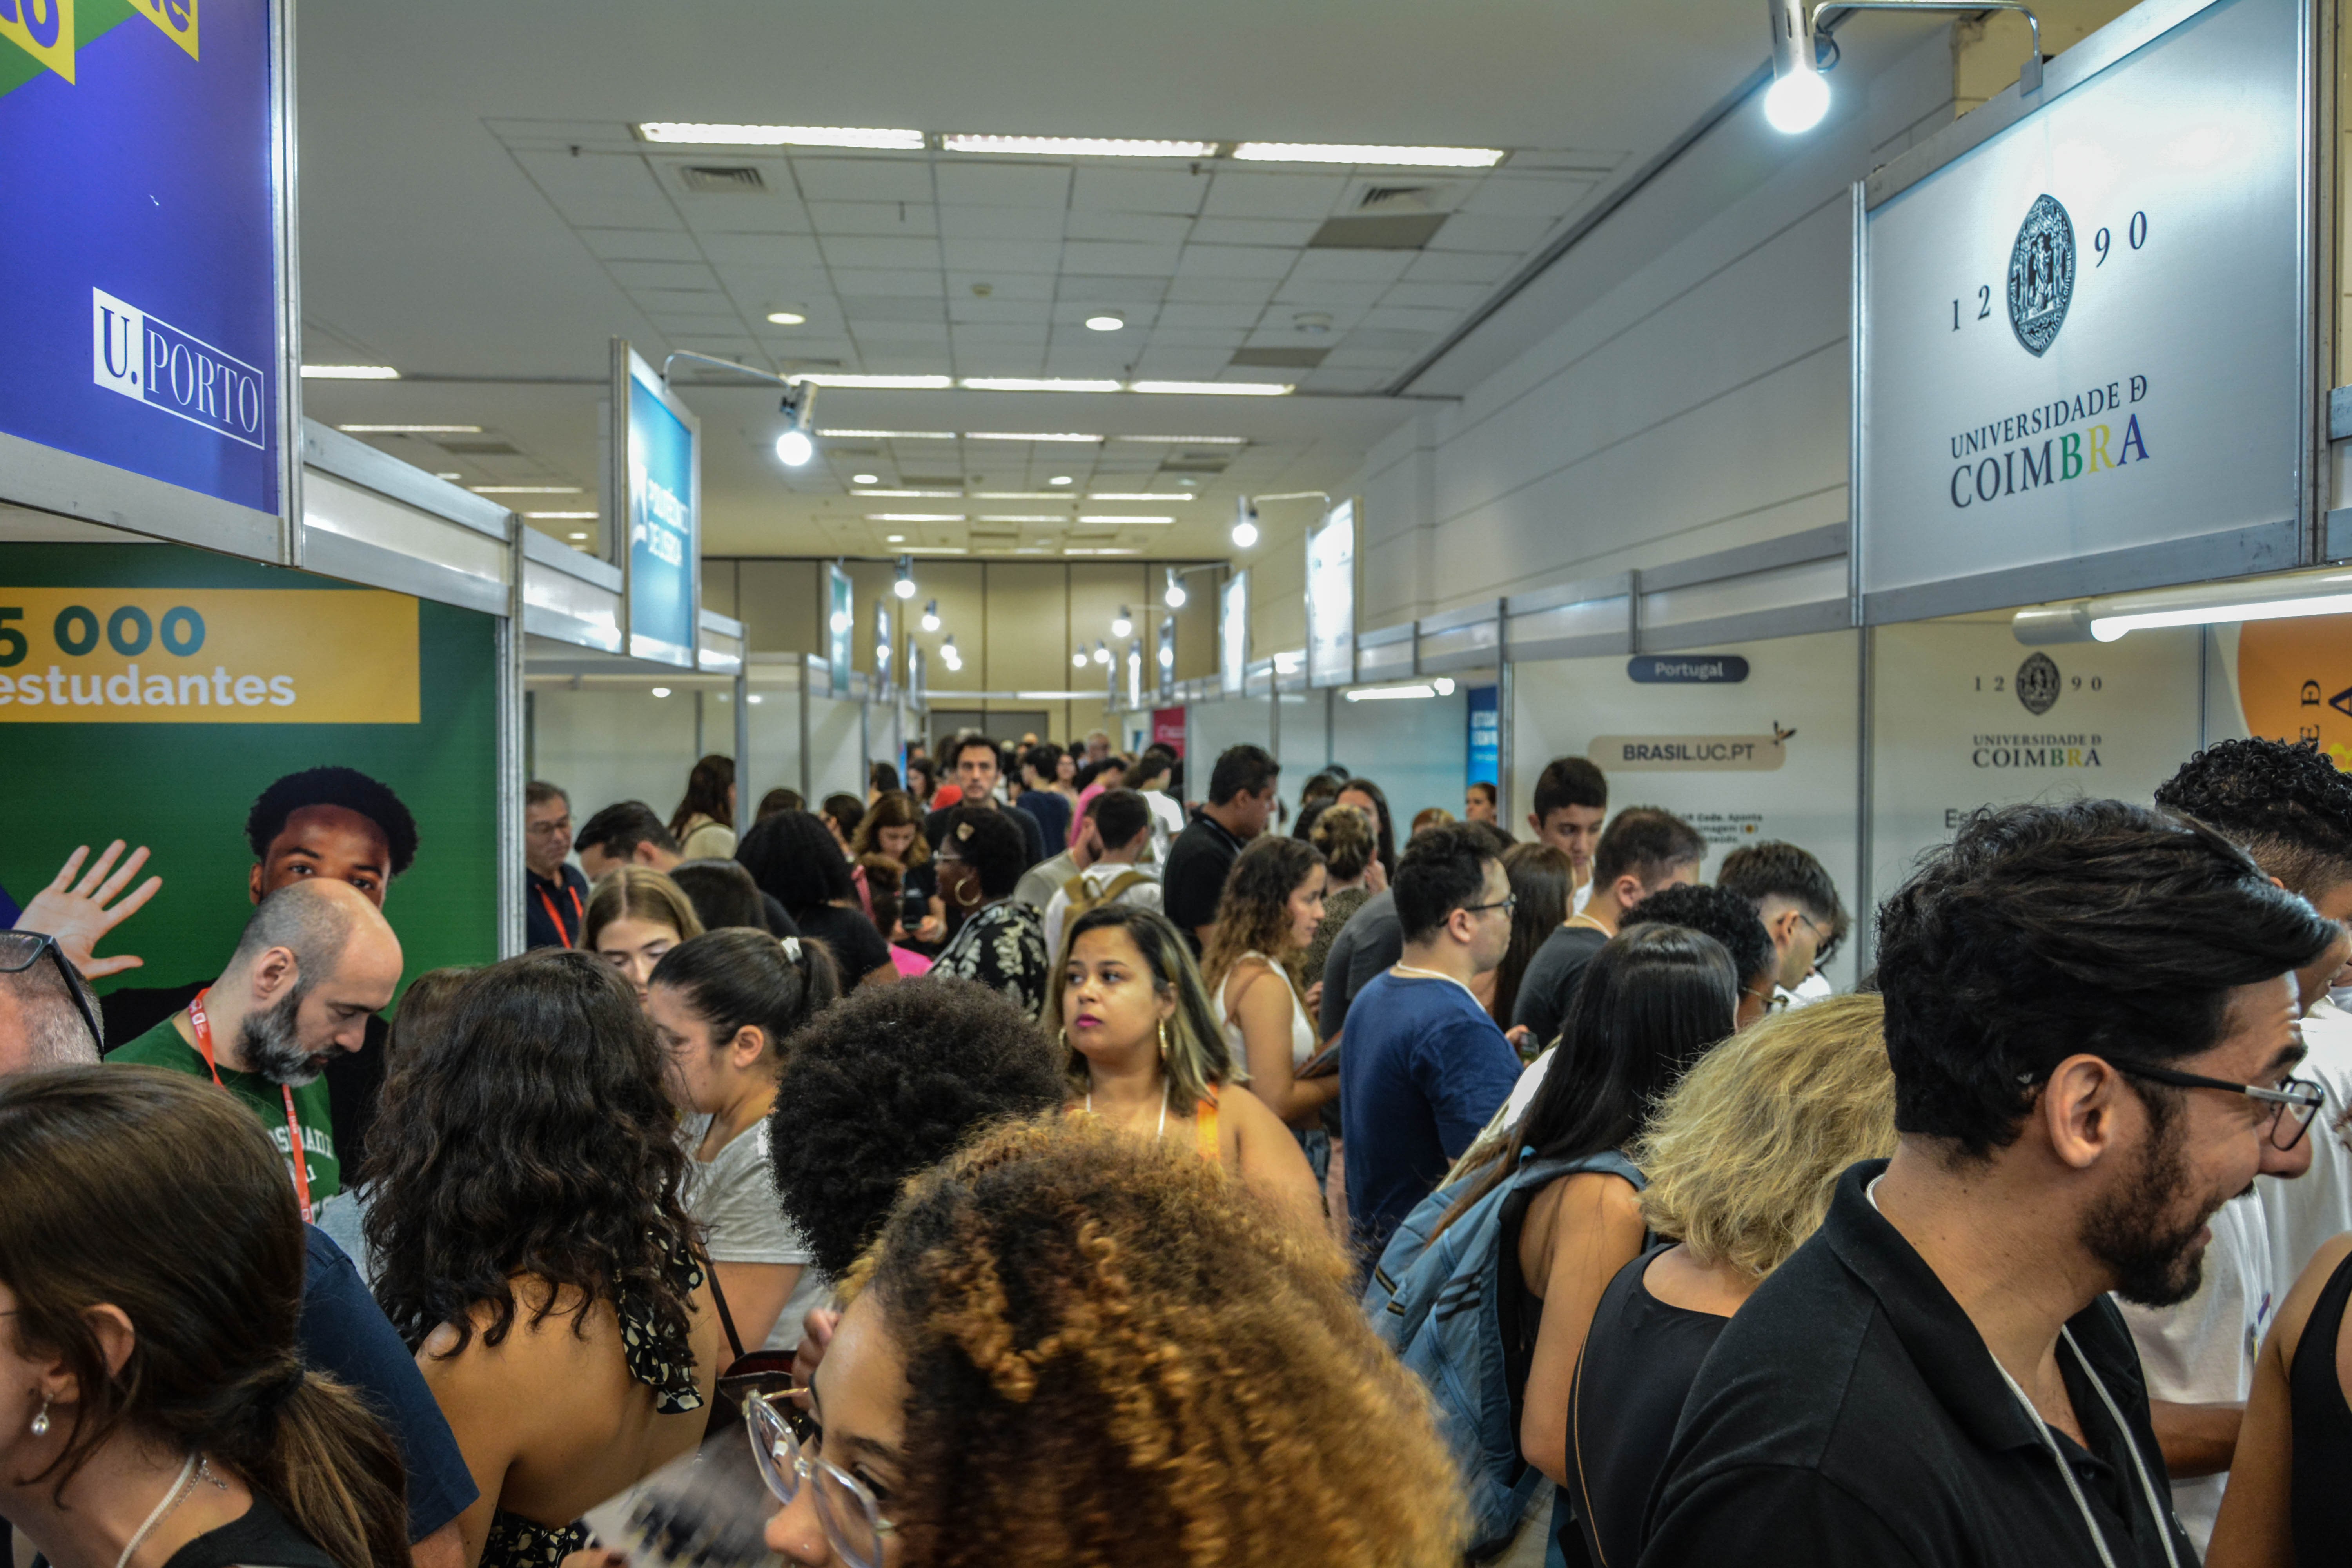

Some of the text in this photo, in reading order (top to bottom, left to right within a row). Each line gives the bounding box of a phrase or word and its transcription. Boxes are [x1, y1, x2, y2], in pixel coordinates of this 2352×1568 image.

[1951, 382, 2120, 459] UNIVERSIDADE
[1950, 413, 2150, 508] COIMBRA
[54, 605, 205, 657] 000
[1654, 661, 1723, 680] Portugal
[1973, 734, 2086, 746] UNIVERSIDADE
[1623, 744, 1755, 761] BRASIL.UC.PT
[1973, 747, 2102, 768] COIMBRA
